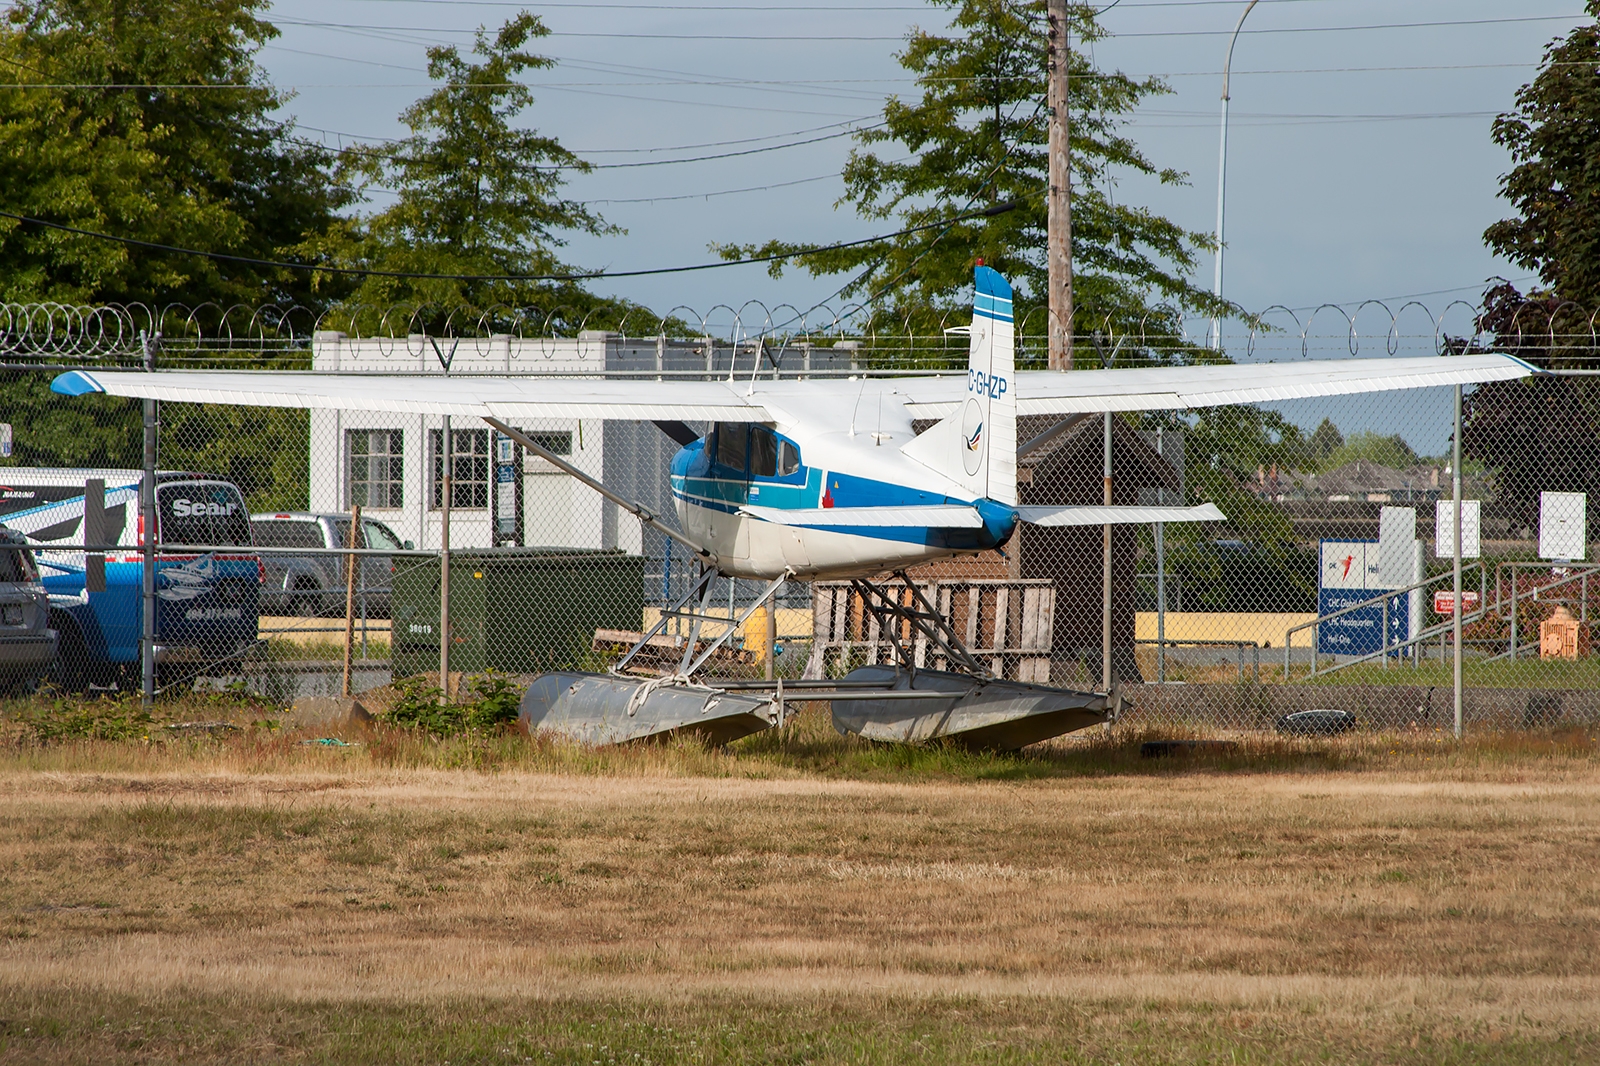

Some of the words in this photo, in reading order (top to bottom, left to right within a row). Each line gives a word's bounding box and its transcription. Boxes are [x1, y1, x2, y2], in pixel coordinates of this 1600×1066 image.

[968, 368, 1007, 400] C-GHZP
[173, 498, 237, 517] Seair
[1367, 564, 1379, 574] Heli
